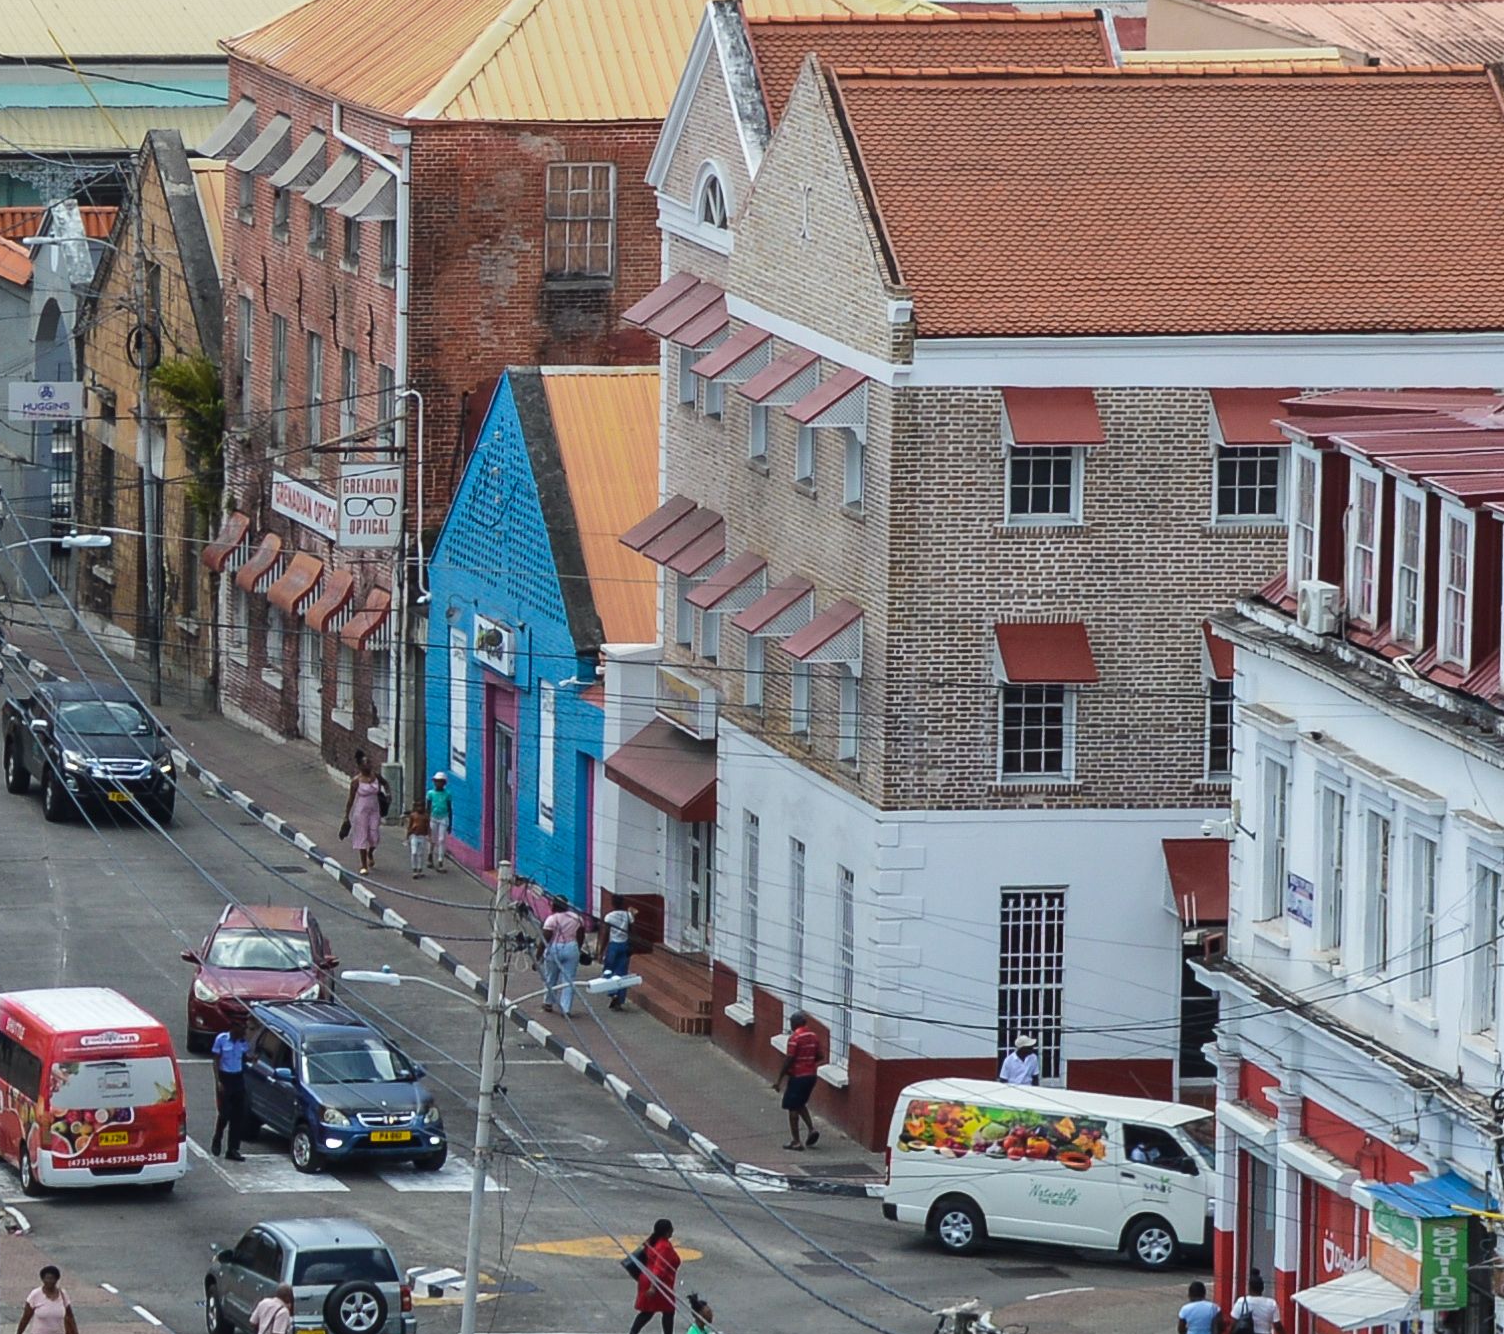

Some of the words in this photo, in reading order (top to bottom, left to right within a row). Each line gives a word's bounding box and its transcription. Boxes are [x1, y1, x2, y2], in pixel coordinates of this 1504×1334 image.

[23, 402, 70, 411] HUGGINS
[343, 478, 399, 494] GRENADIAN
[275, 482, 312, 517] GRENADIAN
[315, 499, 337, 531] OPTICA
[349, 518, 389, 534] OPTICAL
